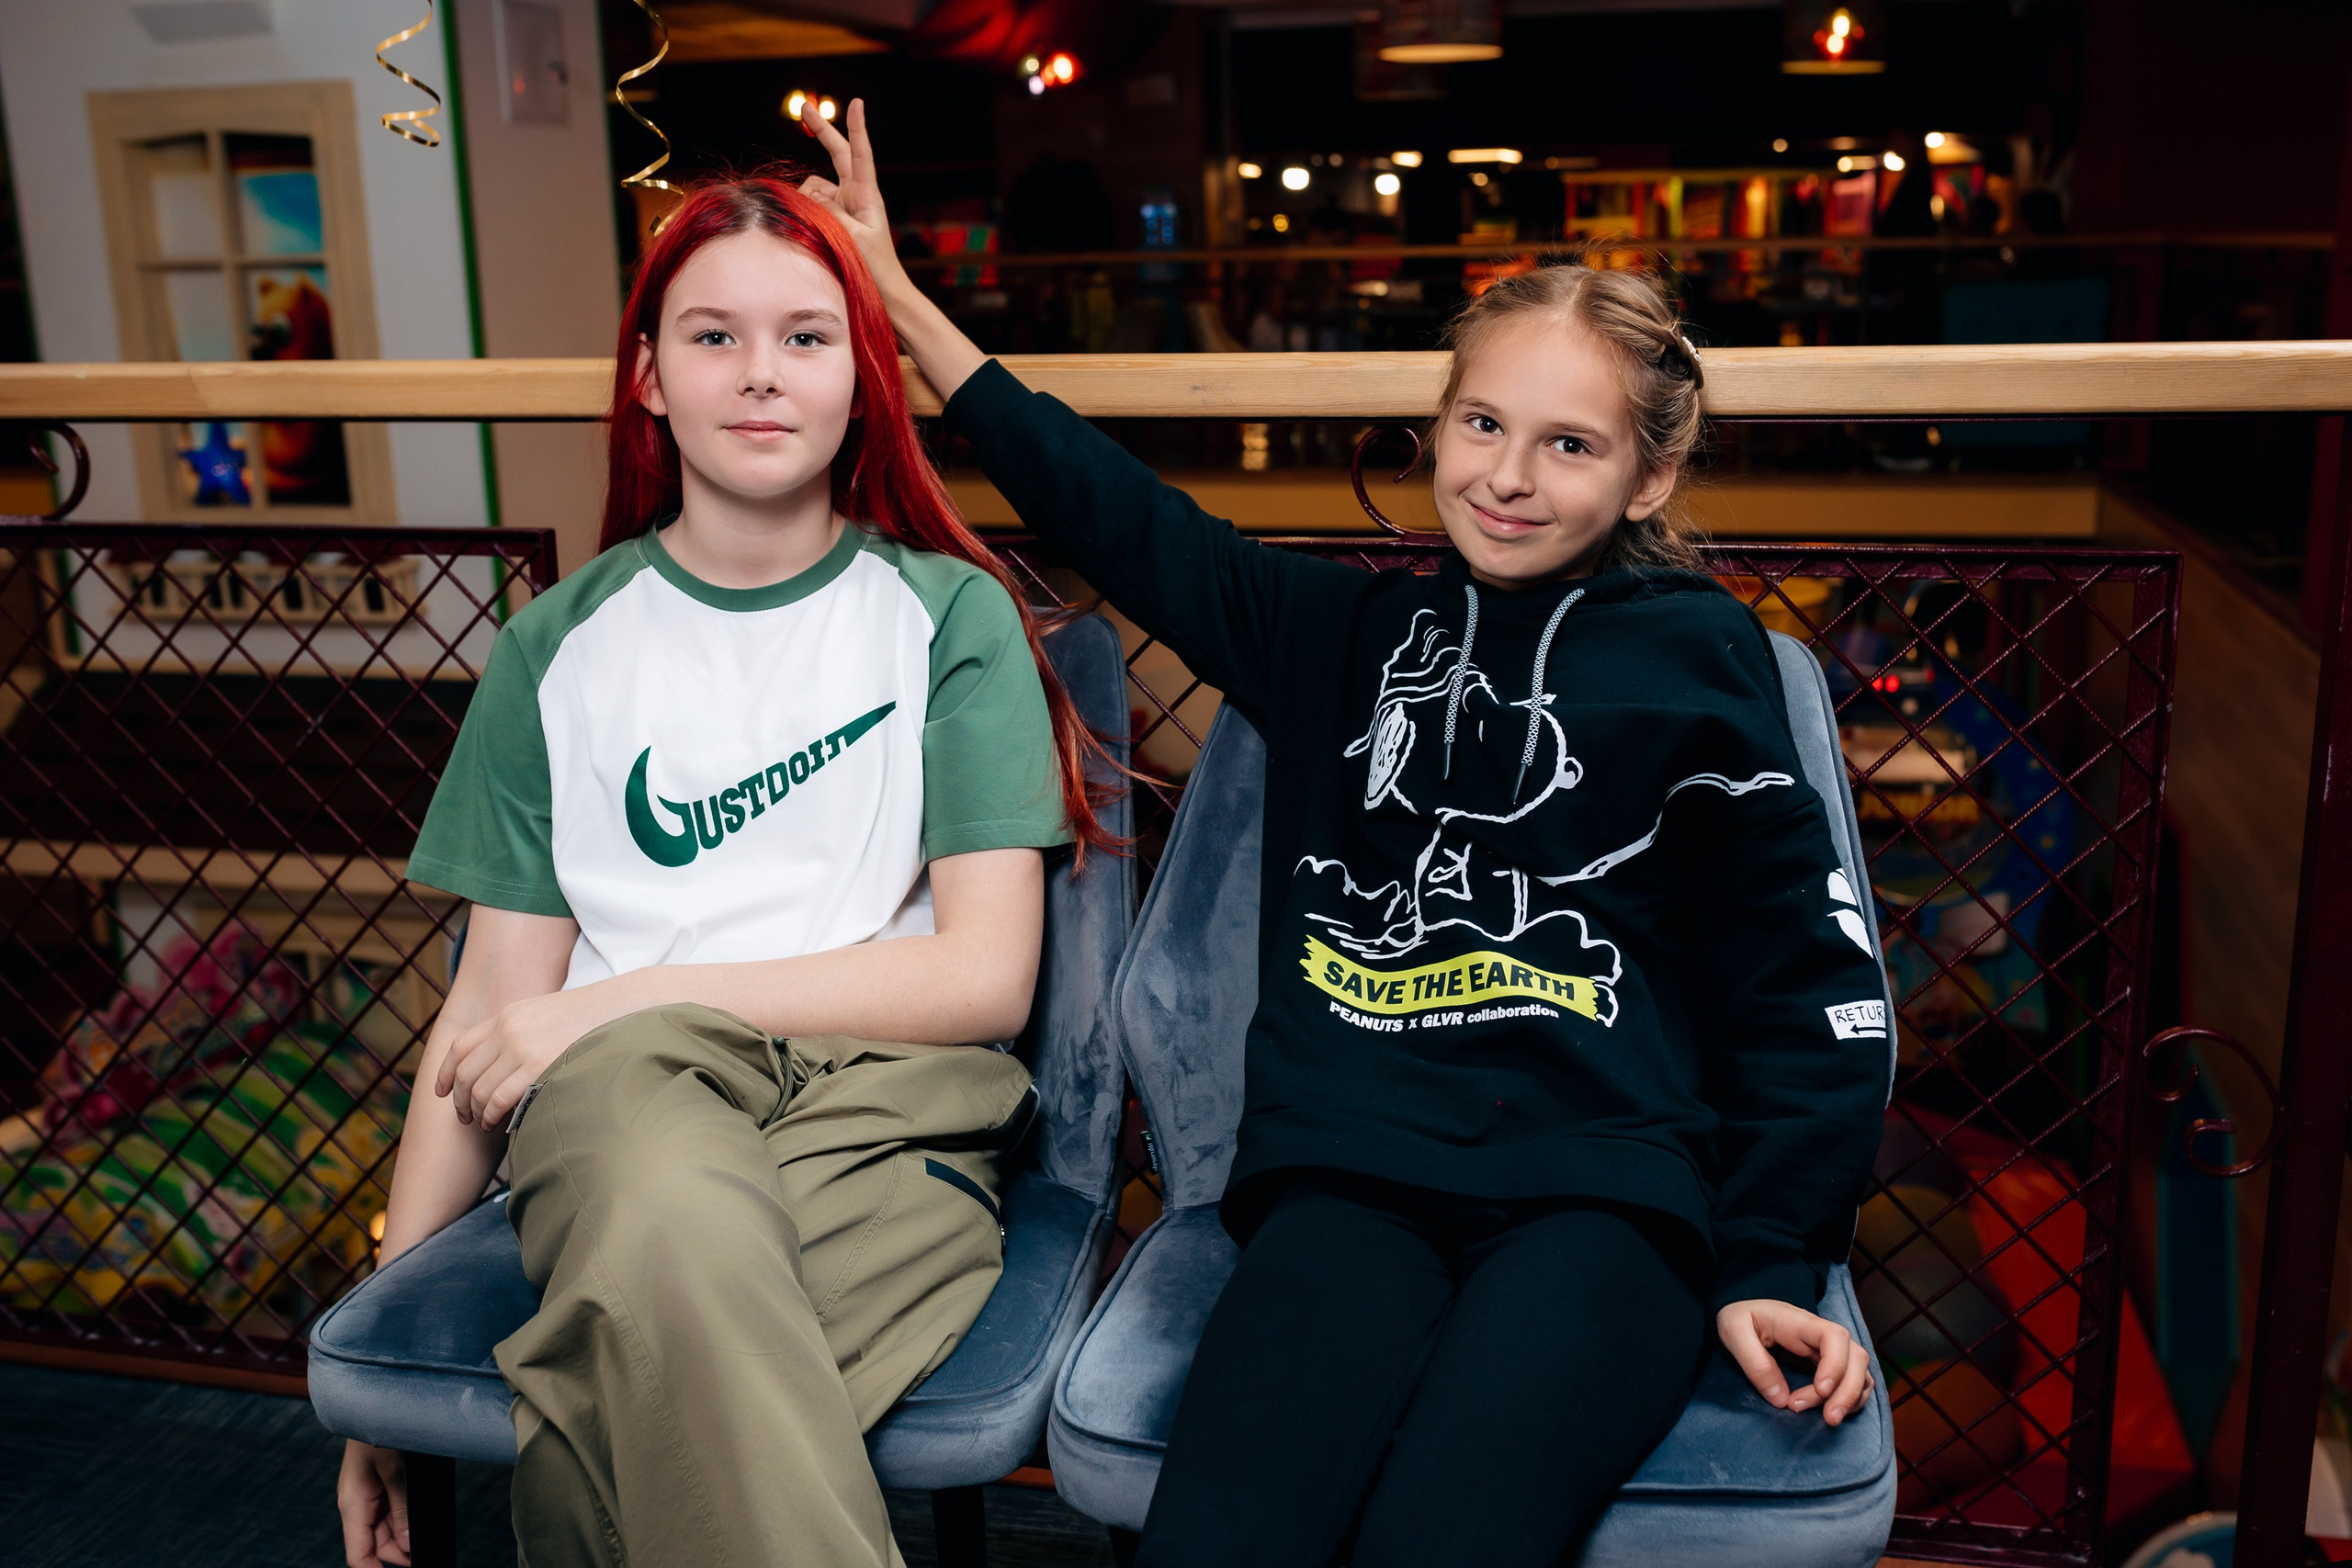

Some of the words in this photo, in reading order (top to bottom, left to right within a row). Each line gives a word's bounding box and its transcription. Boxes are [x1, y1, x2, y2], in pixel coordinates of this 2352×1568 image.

[1323, 960, 1407, 1005] SAVE
[1411, 968, 1464, 1001] THE
[1469, 962, 1577, 1002] EARTH
[1329, 1001, 1404, 1032] PEANUTS
[1421, 1011, 1465, 1028] GLVR
[1466, 1004, 1559, 1024] collaboration
[1834, 1005, 1885, 1024] RETUR
